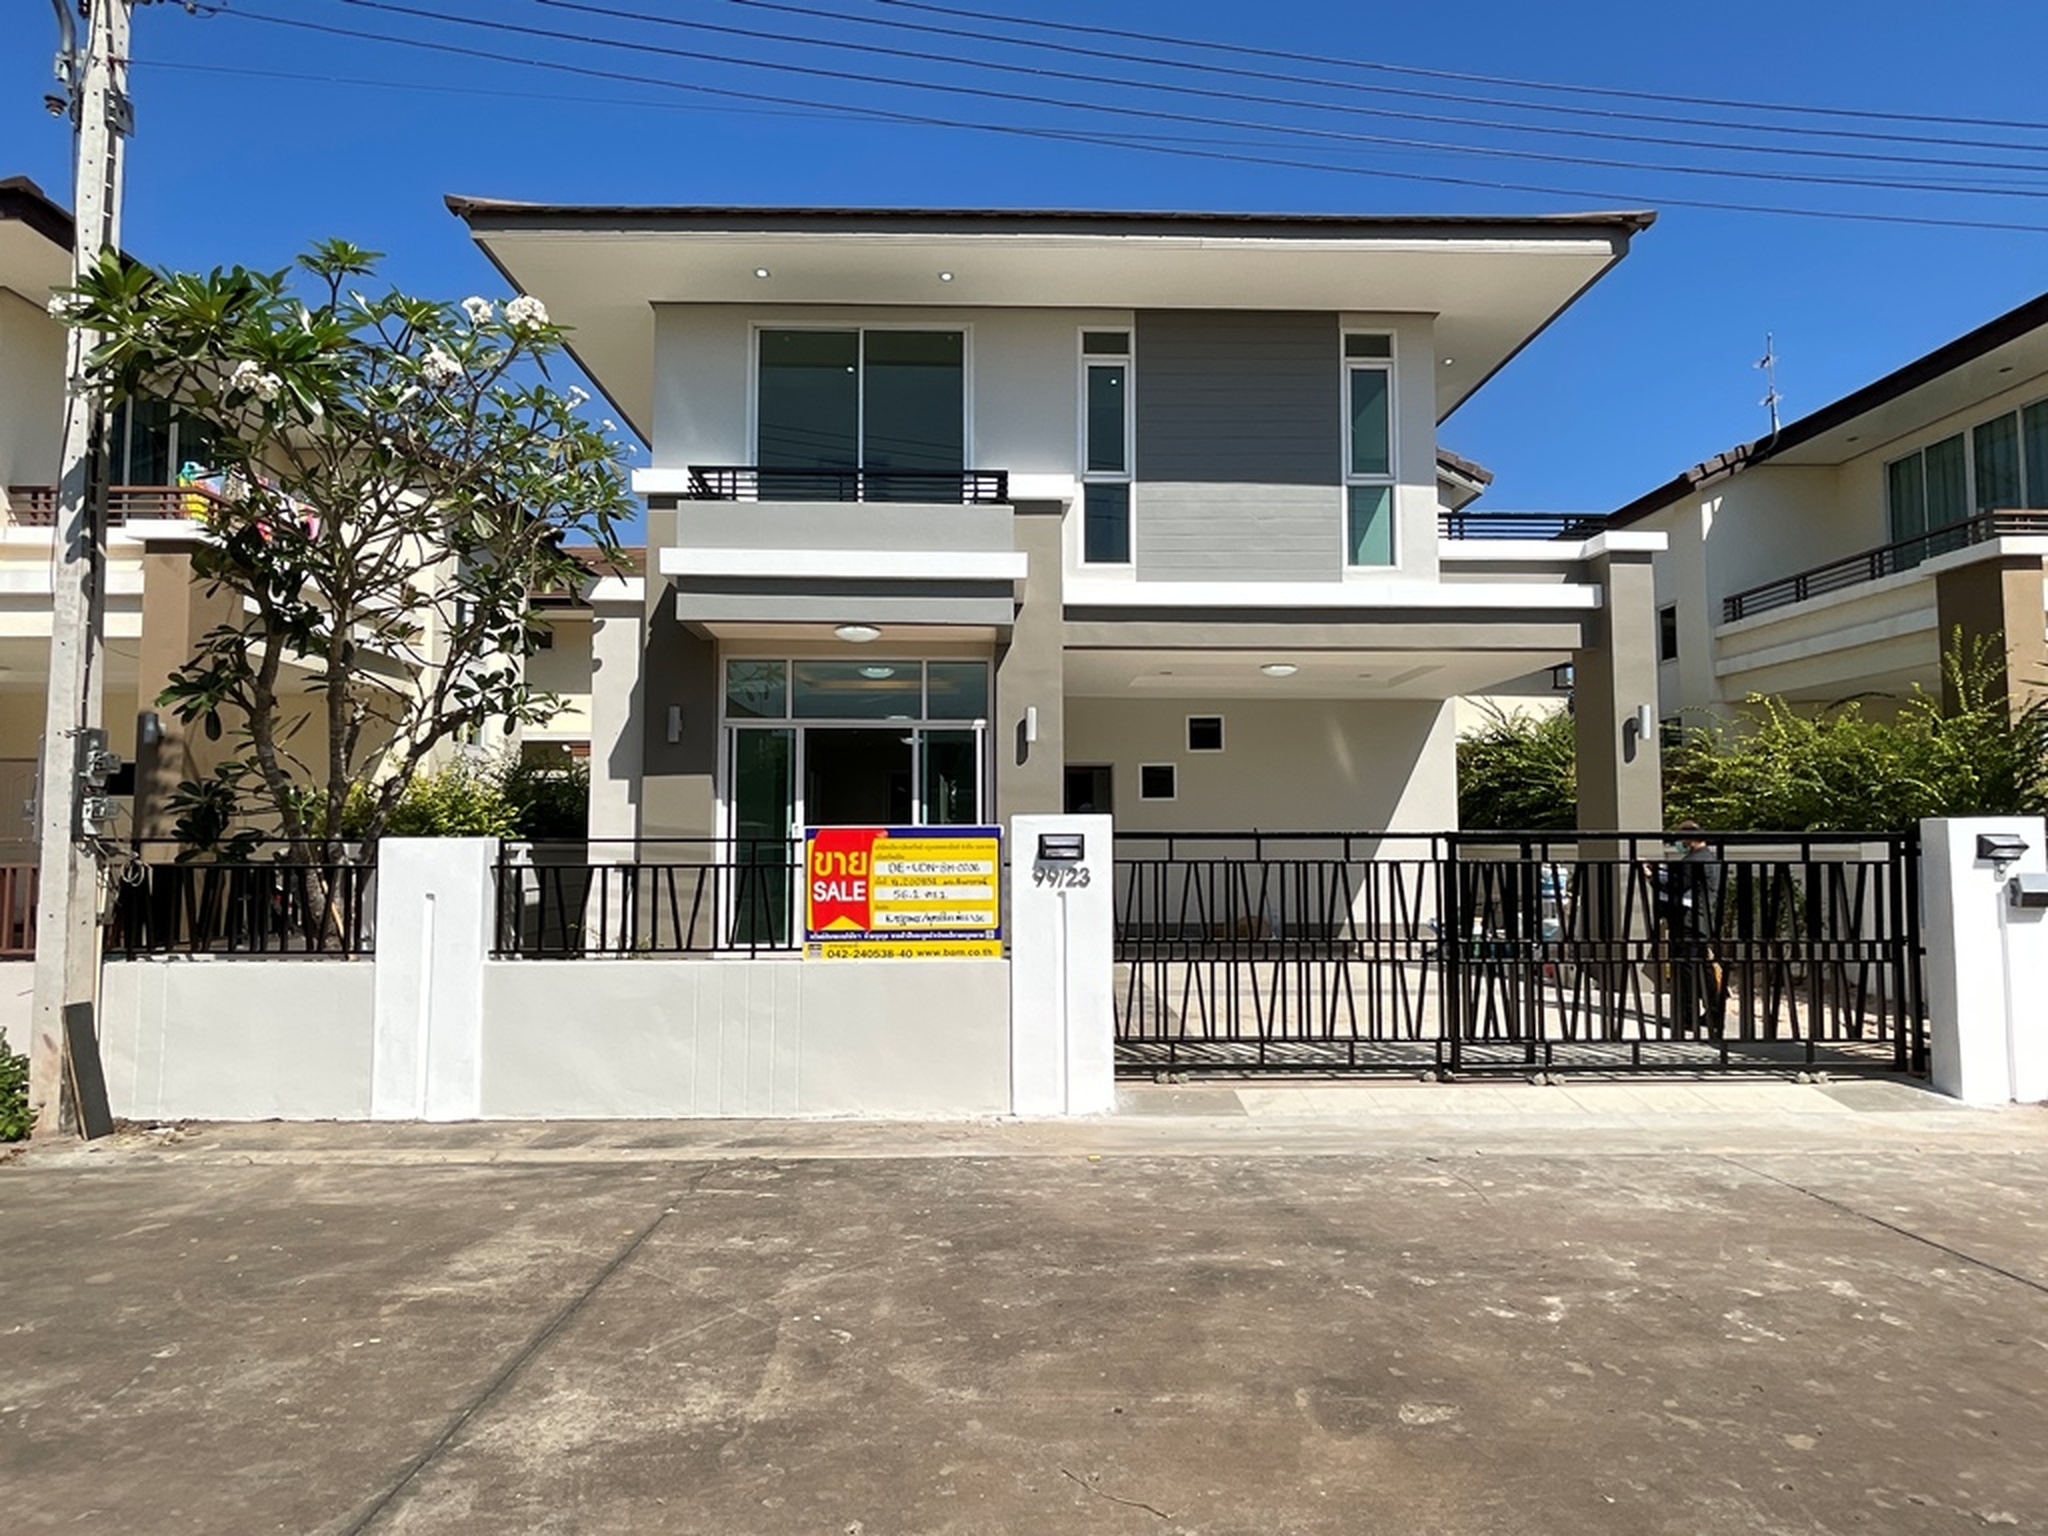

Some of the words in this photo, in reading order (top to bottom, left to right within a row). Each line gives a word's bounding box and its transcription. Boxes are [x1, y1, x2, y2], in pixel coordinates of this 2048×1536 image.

[815, 851, 867, 876] ขาย
[1032, 867, 1091, 888] 99/23
[813, 881, 867, 901] SALE
[917, 948, 993, 957] www.bam.co.th
